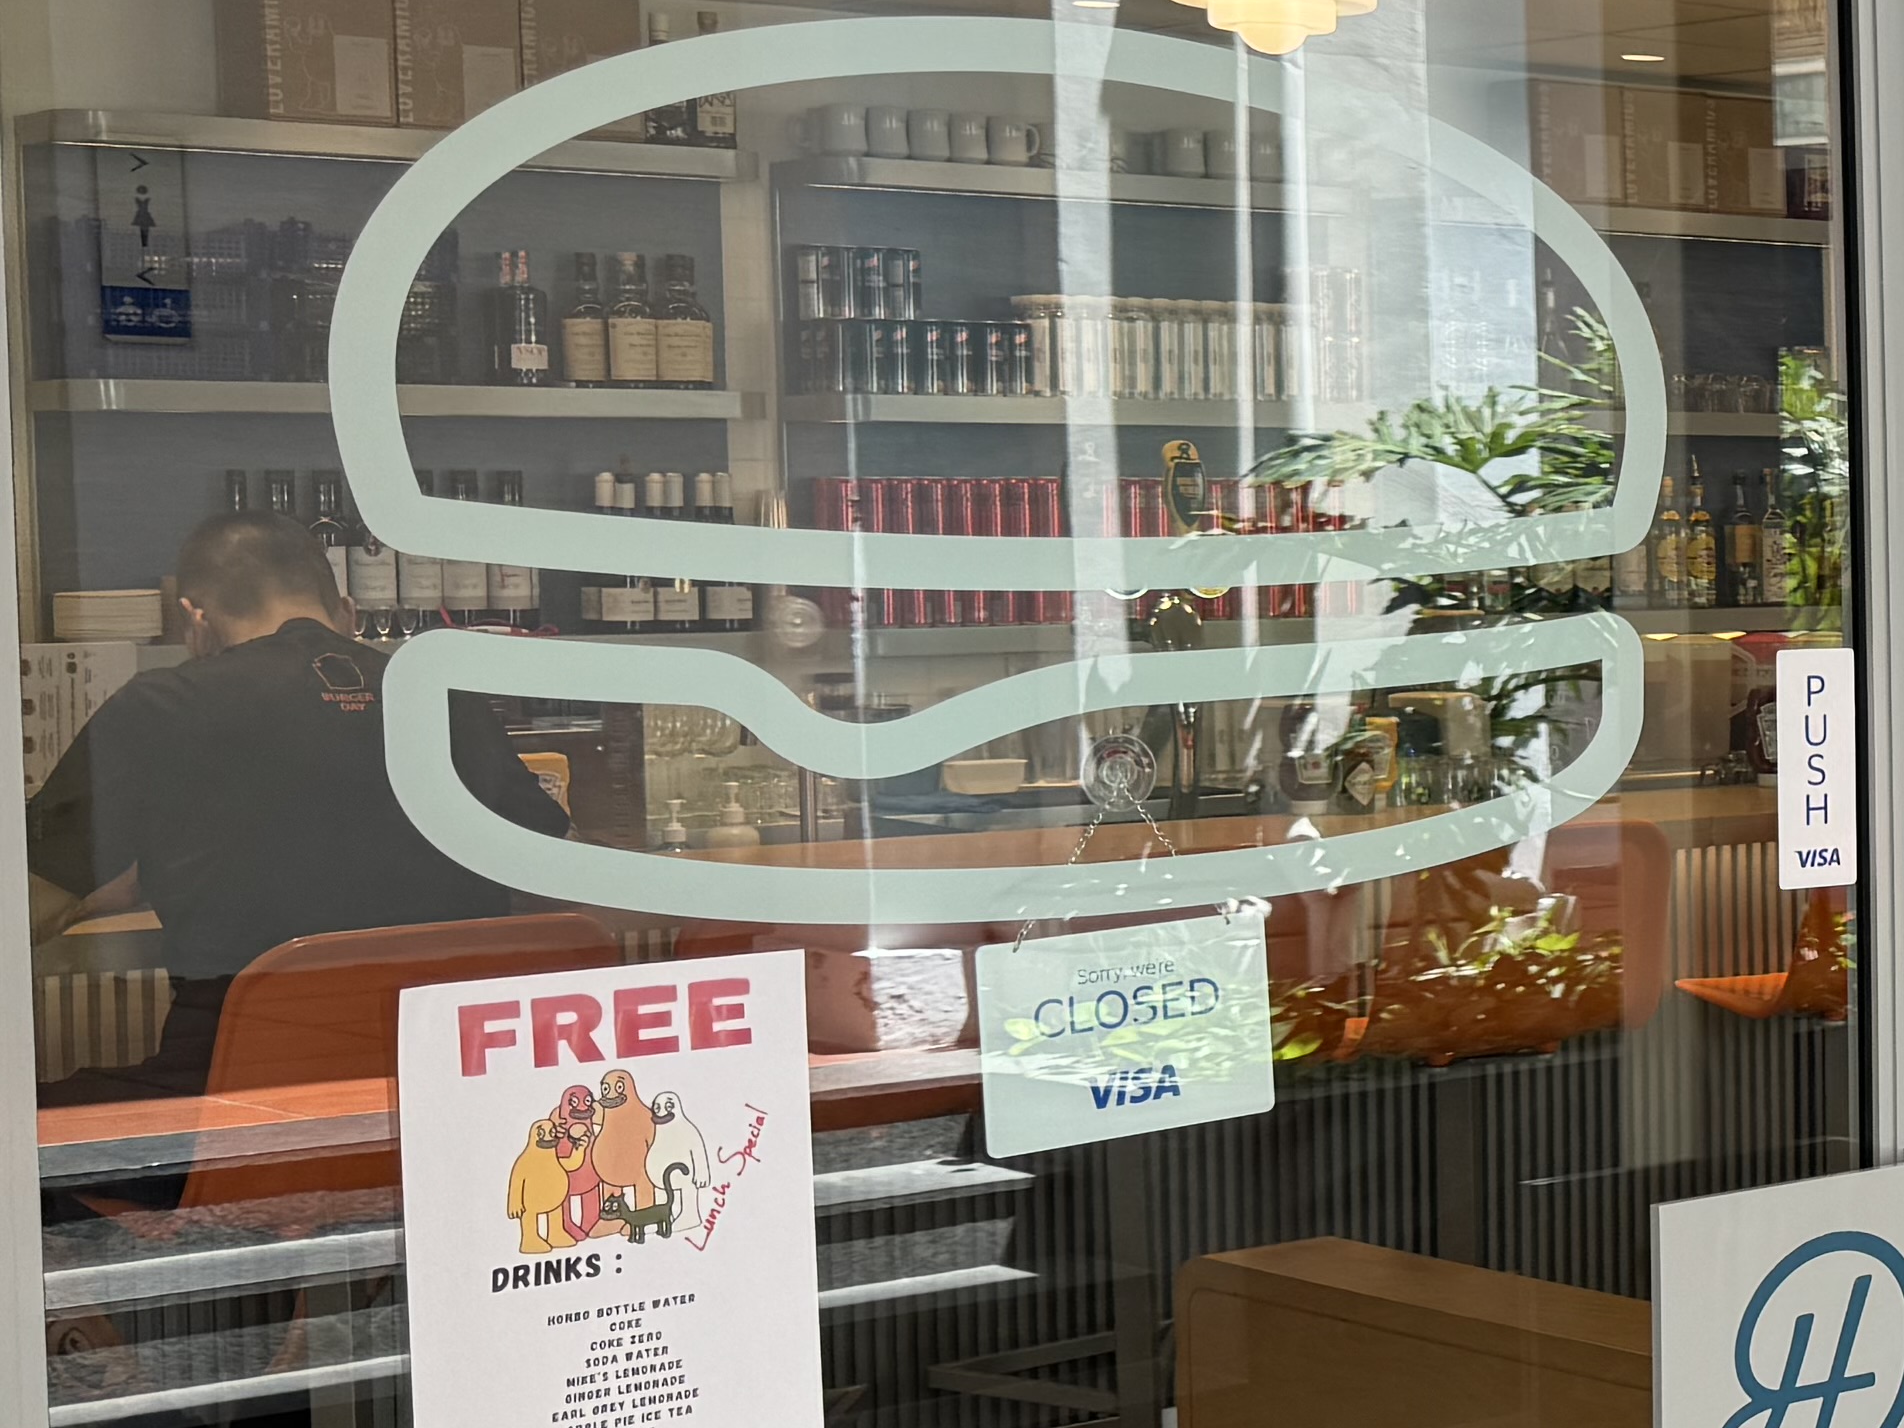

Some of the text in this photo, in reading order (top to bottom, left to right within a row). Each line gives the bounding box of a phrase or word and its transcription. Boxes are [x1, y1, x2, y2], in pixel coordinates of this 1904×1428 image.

[1804, 674, 1828, 826] PUSH
[1794, 847, 1841, 868] VISA
[1033, 977, 1220, 1039] CLOSED
[458, 978, 752, 1077] FREE
[1087, 1064, 1181, 1109] VISA
[685, 1104, 768, 1252] Lunch Special
[492, 1253, 601, 1293] DRINKS
[597, 1301, 646, 1318] BOTTLE
[652, 1293, 696, 1309] WATER
[609, 1318, 642, 1332] COKE
[585, 1346, 669, 1369] SODA WATER
[591, 1337, 623, 1352] COKE
[566, 1359, 683, 1388] MIKE'S LEMONADE
[618, 1375, 686, 1395] LEMONADE
[552, 1409, 586, 1423] EARL
[632, 1388, 700, 1409] LEMONADE
[615, 1415, 635, 1428] PIE
[641, 1410, 661, 1424] ICE
[668, 1405, 693, 1418] TEA
